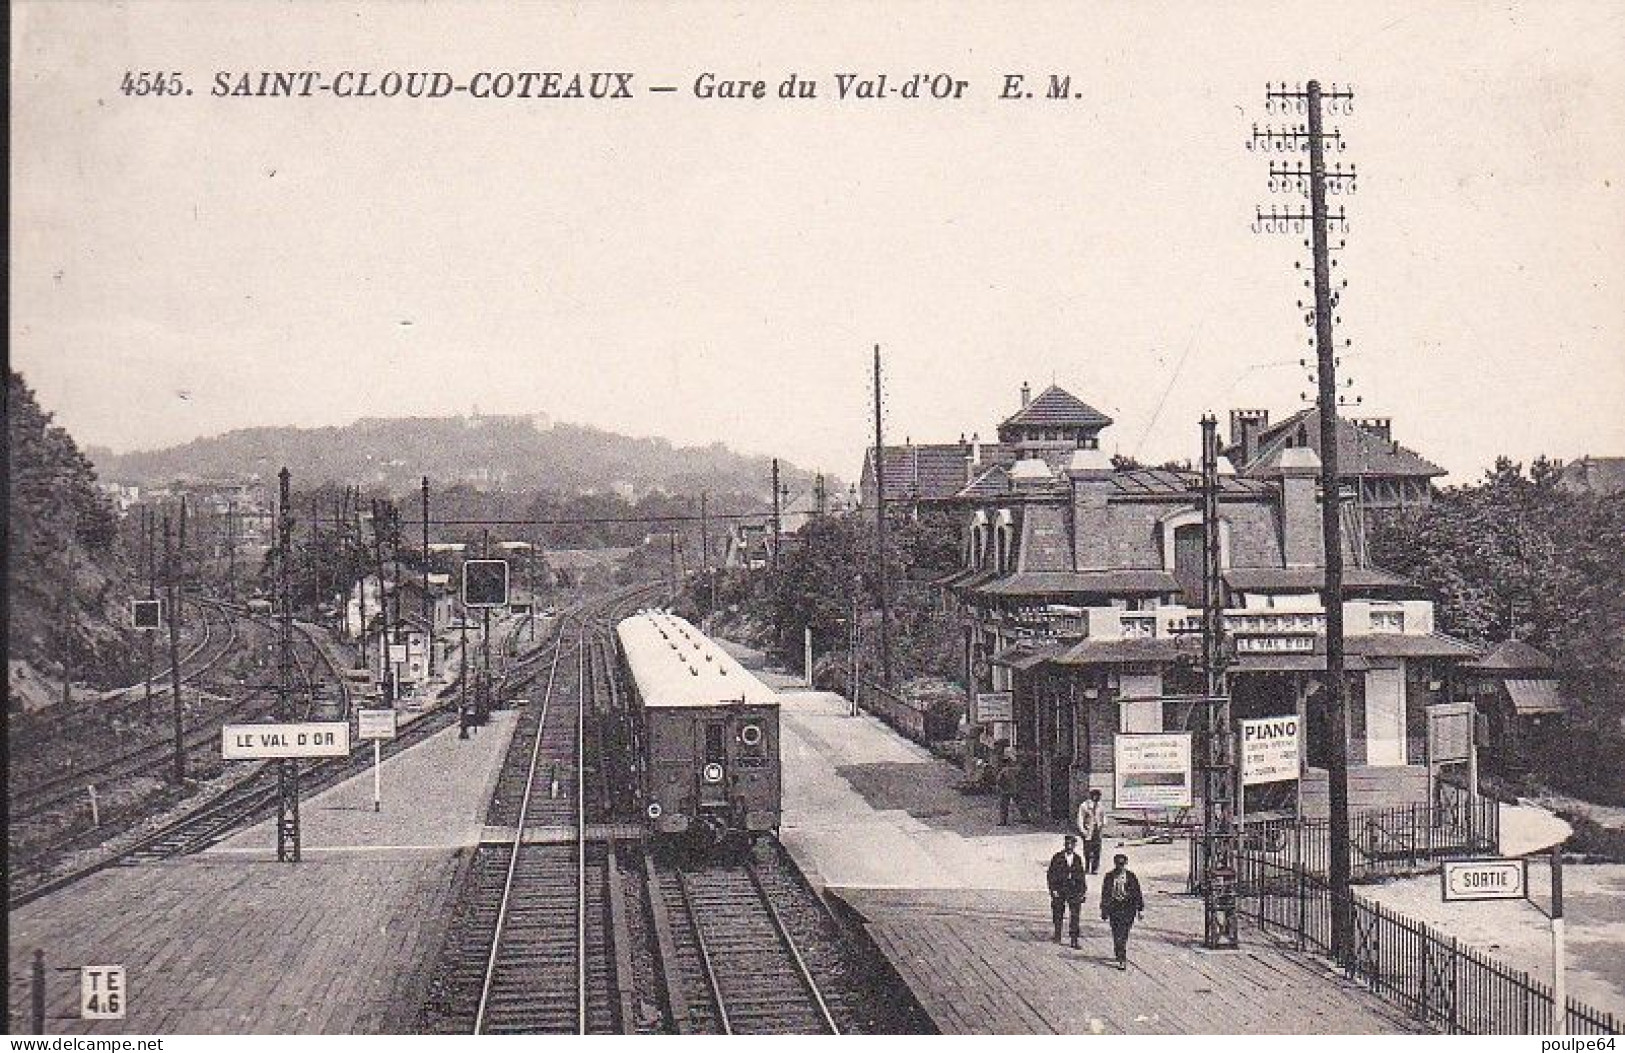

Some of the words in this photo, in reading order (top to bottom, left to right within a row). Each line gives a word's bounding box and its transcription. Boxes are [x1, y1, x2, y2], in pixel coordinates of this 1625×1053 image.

[1245, 722, 1297, 741] PIANO
[237, 734, 253, 748] LE
[261, 733, 289, 747] VAL
[297, 732, 335, 747] D'OR
[1463, 872, 1509, 887] SORTIE
